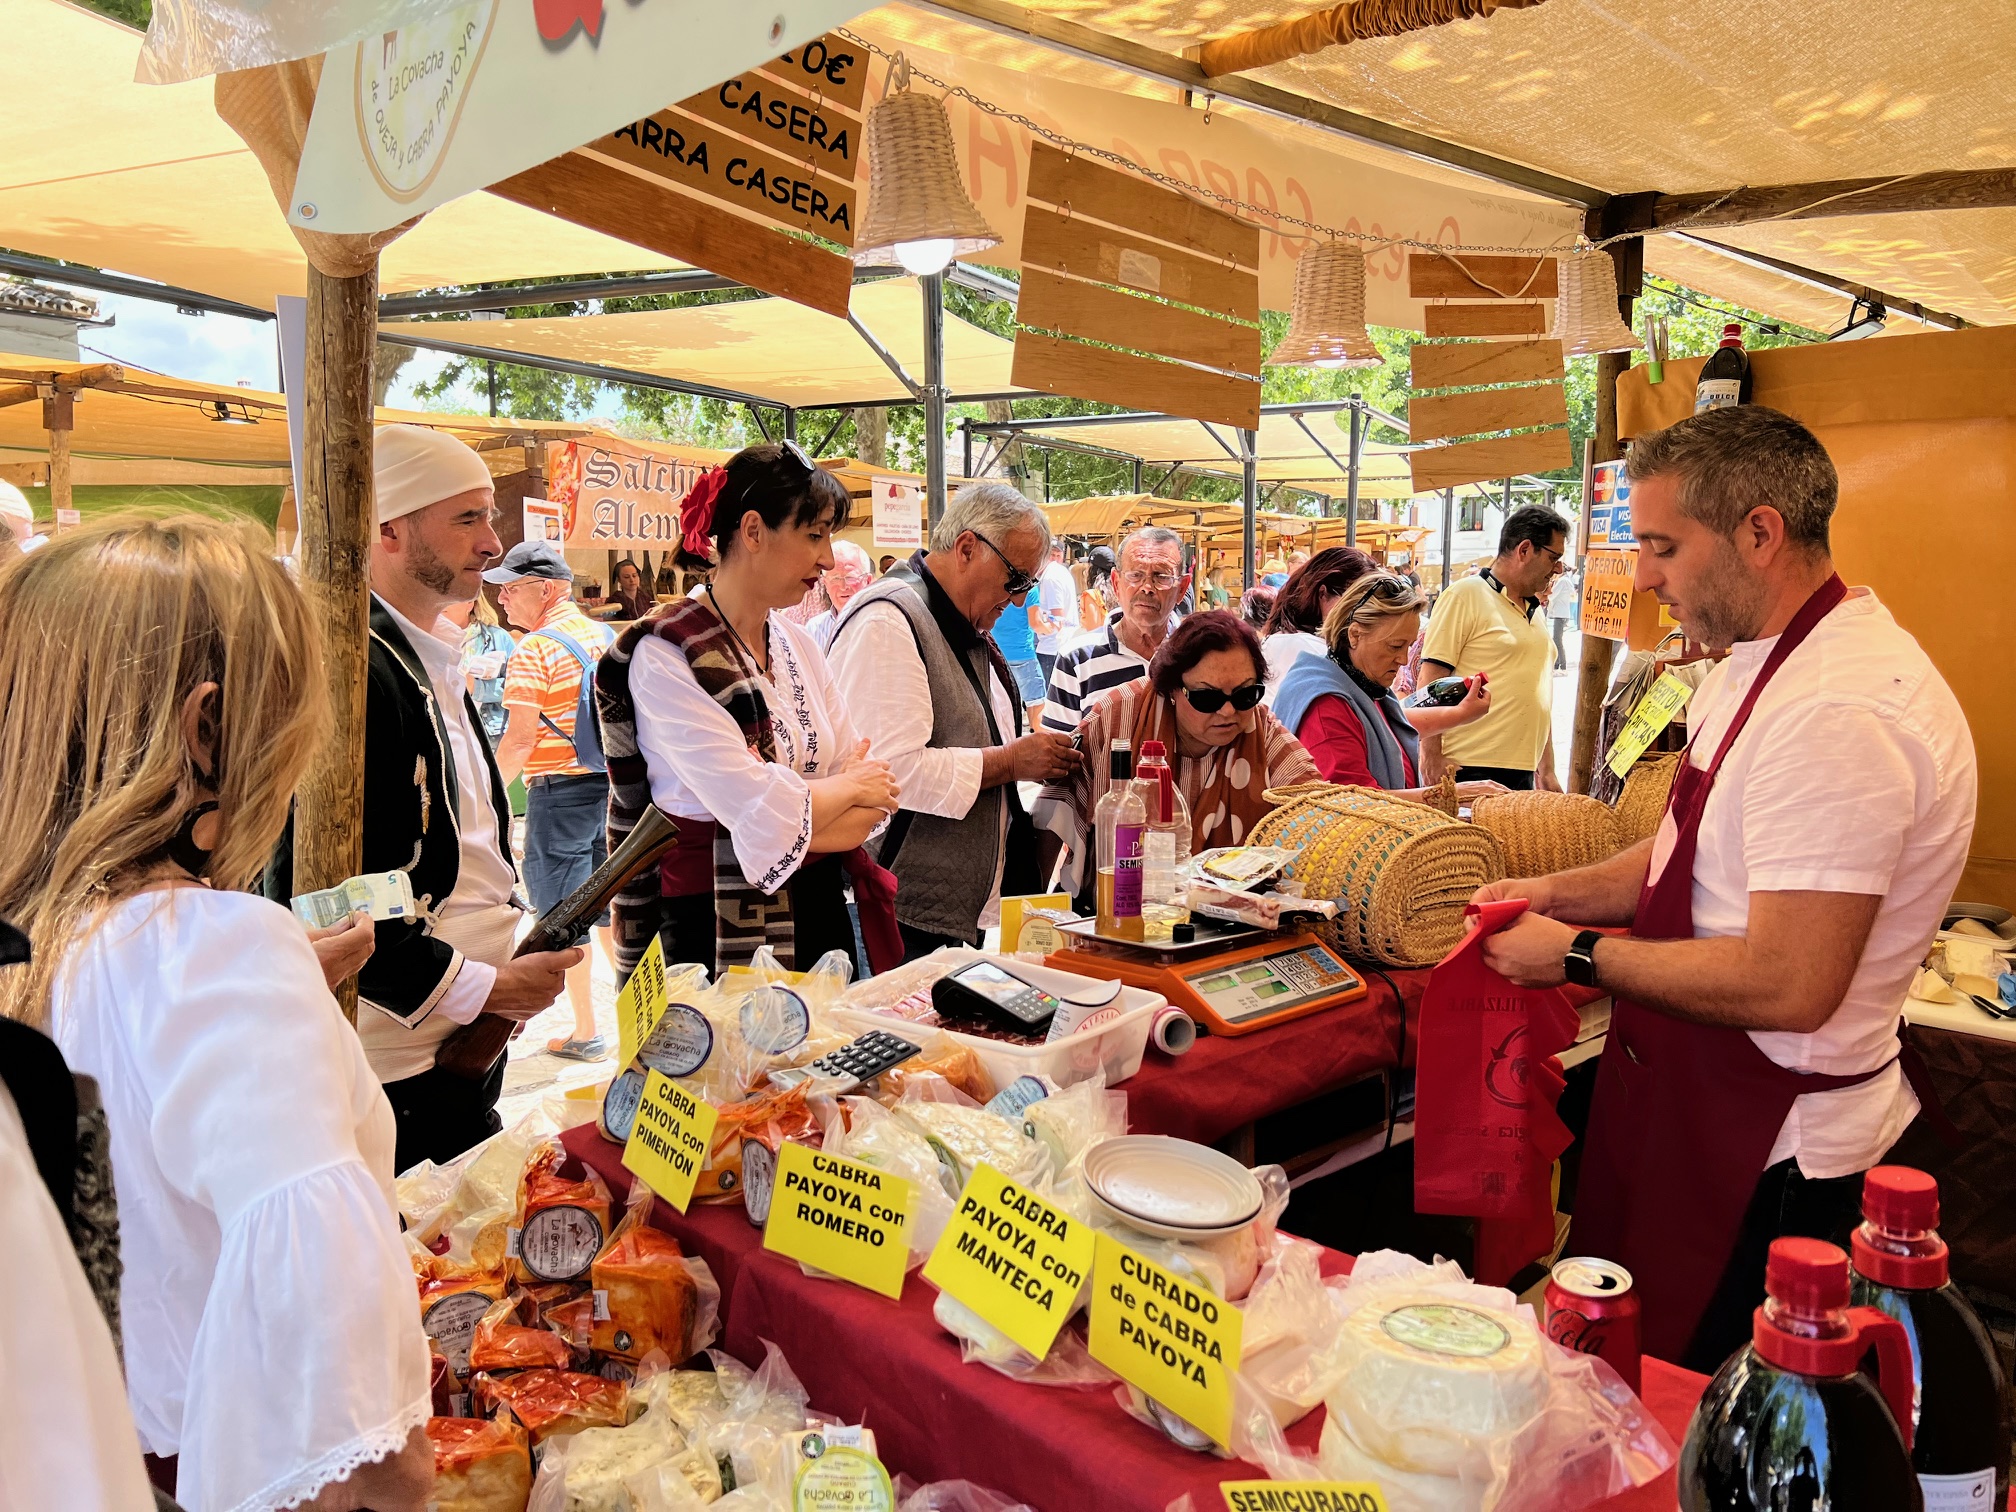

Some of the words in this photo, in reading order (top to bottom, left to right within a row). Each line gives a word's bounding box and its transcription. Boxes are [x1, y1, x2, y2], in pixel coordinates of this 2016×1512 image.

[376, 109, 398, 160] OVEJA
[398, 151, 404, 170] y
[407, 119, 434, 164] CABRA
[436, 21, 475, 124] PAYOYA
[389, 75, 400, 101] La
[402, 51, 444, 92] Covacha
[719, 80, 849, 160] CASERA
[725, 158, 850, 231] CASERA
[1592, 519, 1607, 533] VISA
[1586, 586, 1592, 604] 4
[1593, 590, 1628, 610] PIEZAS
[388, 874, 396, 885] 5
[632, 972, 643, 1015] ACEITE
[641, 957, 654, 1007] PAYOYA
[653, 954, 664, 999] CABRA
[636, 1012, 644, 1050] OLIVA
[645, 1006, 653, 1032] con
[648, 1037, 661, 1047] La
[659, 1082, 696, 1119] CABRA
[640, 1097, 680, 1138] PAYOYA
[682, 1132, 704, 1155] con
[636, 1123, 694, 1177] PIMENTÓN
[812, 1156, 881, 1191] CABRA
[785, 1171, 862, 1213] PAYOYA
[869, 1204, 905, 1227] con
[999, 1185, 1068, 1242] CABRA
[551, 1219, 561, 1231] La
[797, 1202, 885, 1247] ROMERO
[960, 1196, 1037, 1260] PAYOYA
[1041, 1254, 1081, 1289] con
[956, 1232, 1055, 1312] MANTECA
[1120, 1255, 1219, 1324] CURADO
[1110, 1283, 1136, 1310] de
[1144, 1301, 1223, 1363] CABRA
[1119, 1317, 1207, 1389] PAYOYA
[858, 1489, 875, 1504] La
[1230, 1489, 1380, 1512] SEMICURADO
